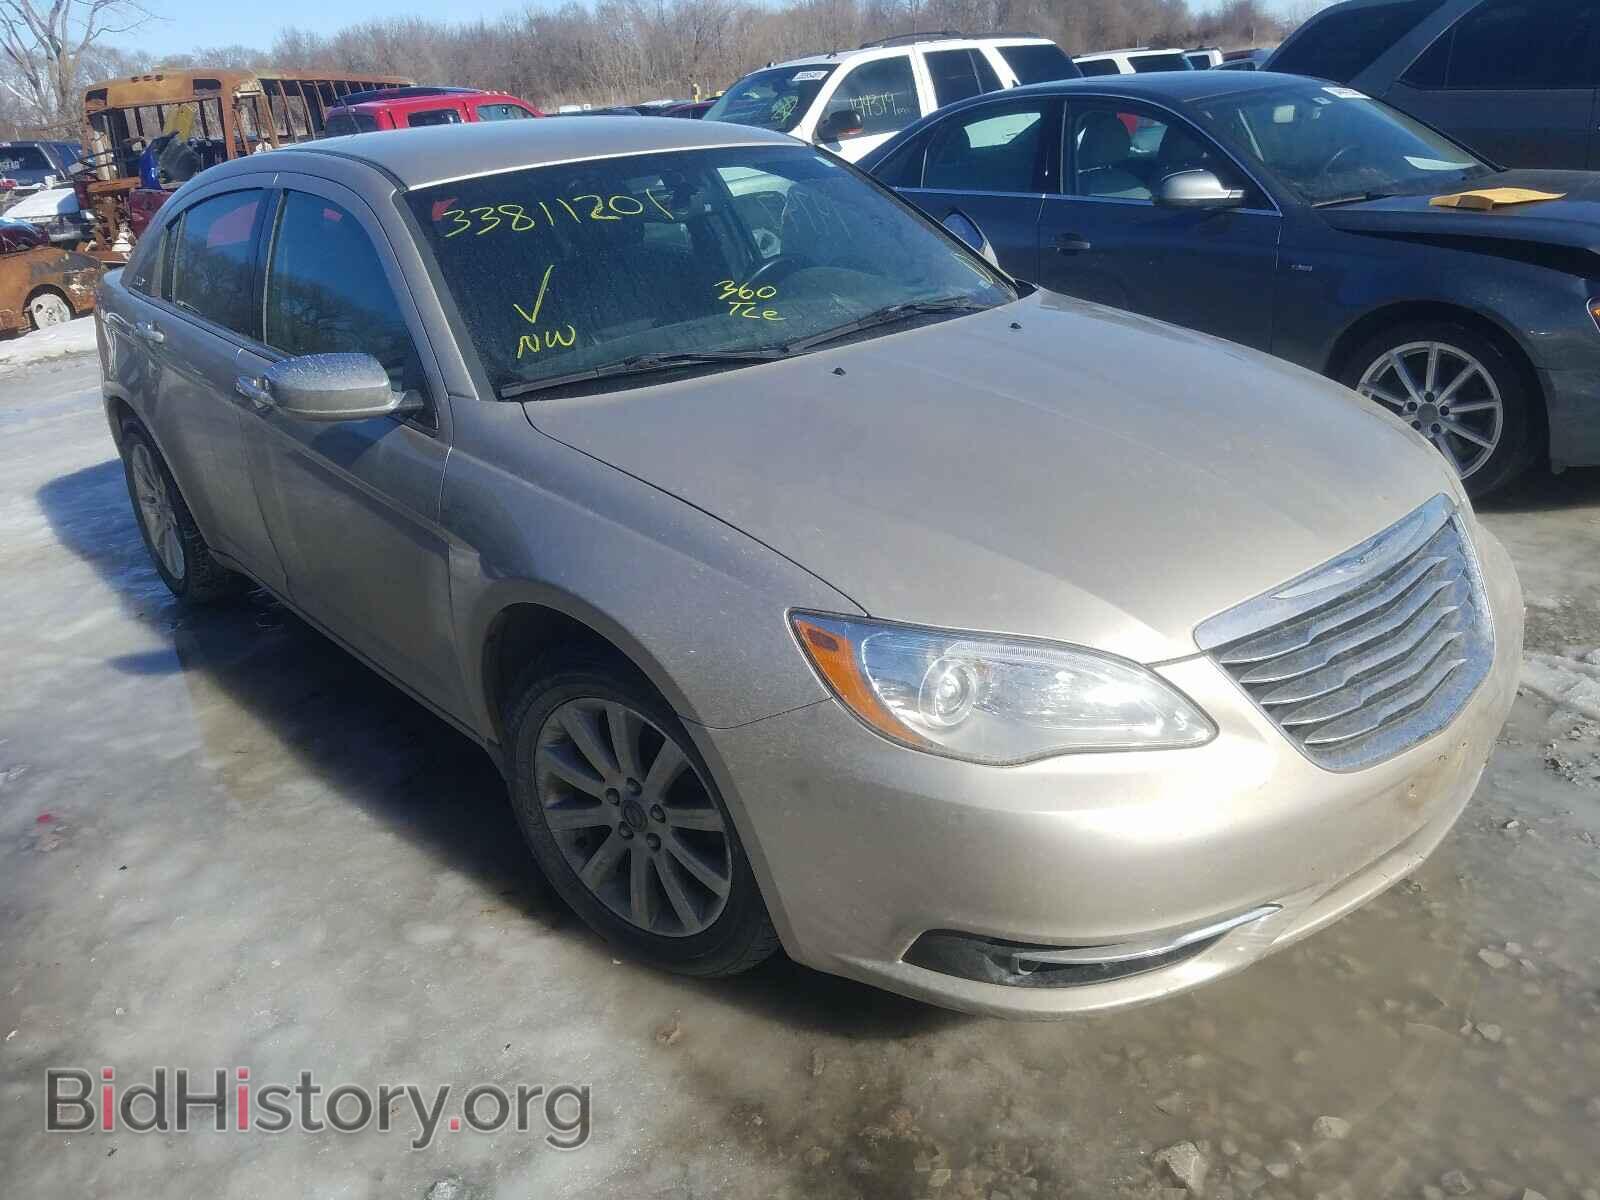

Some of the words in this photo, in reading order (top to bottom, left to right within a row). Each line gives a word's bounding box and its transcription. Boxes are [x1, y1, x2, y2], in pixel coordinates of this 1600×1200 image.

[442, 188, 675, 238] 33811201
[713, 280, 777, 300] 360
[516, 324, 576, 359] NW
